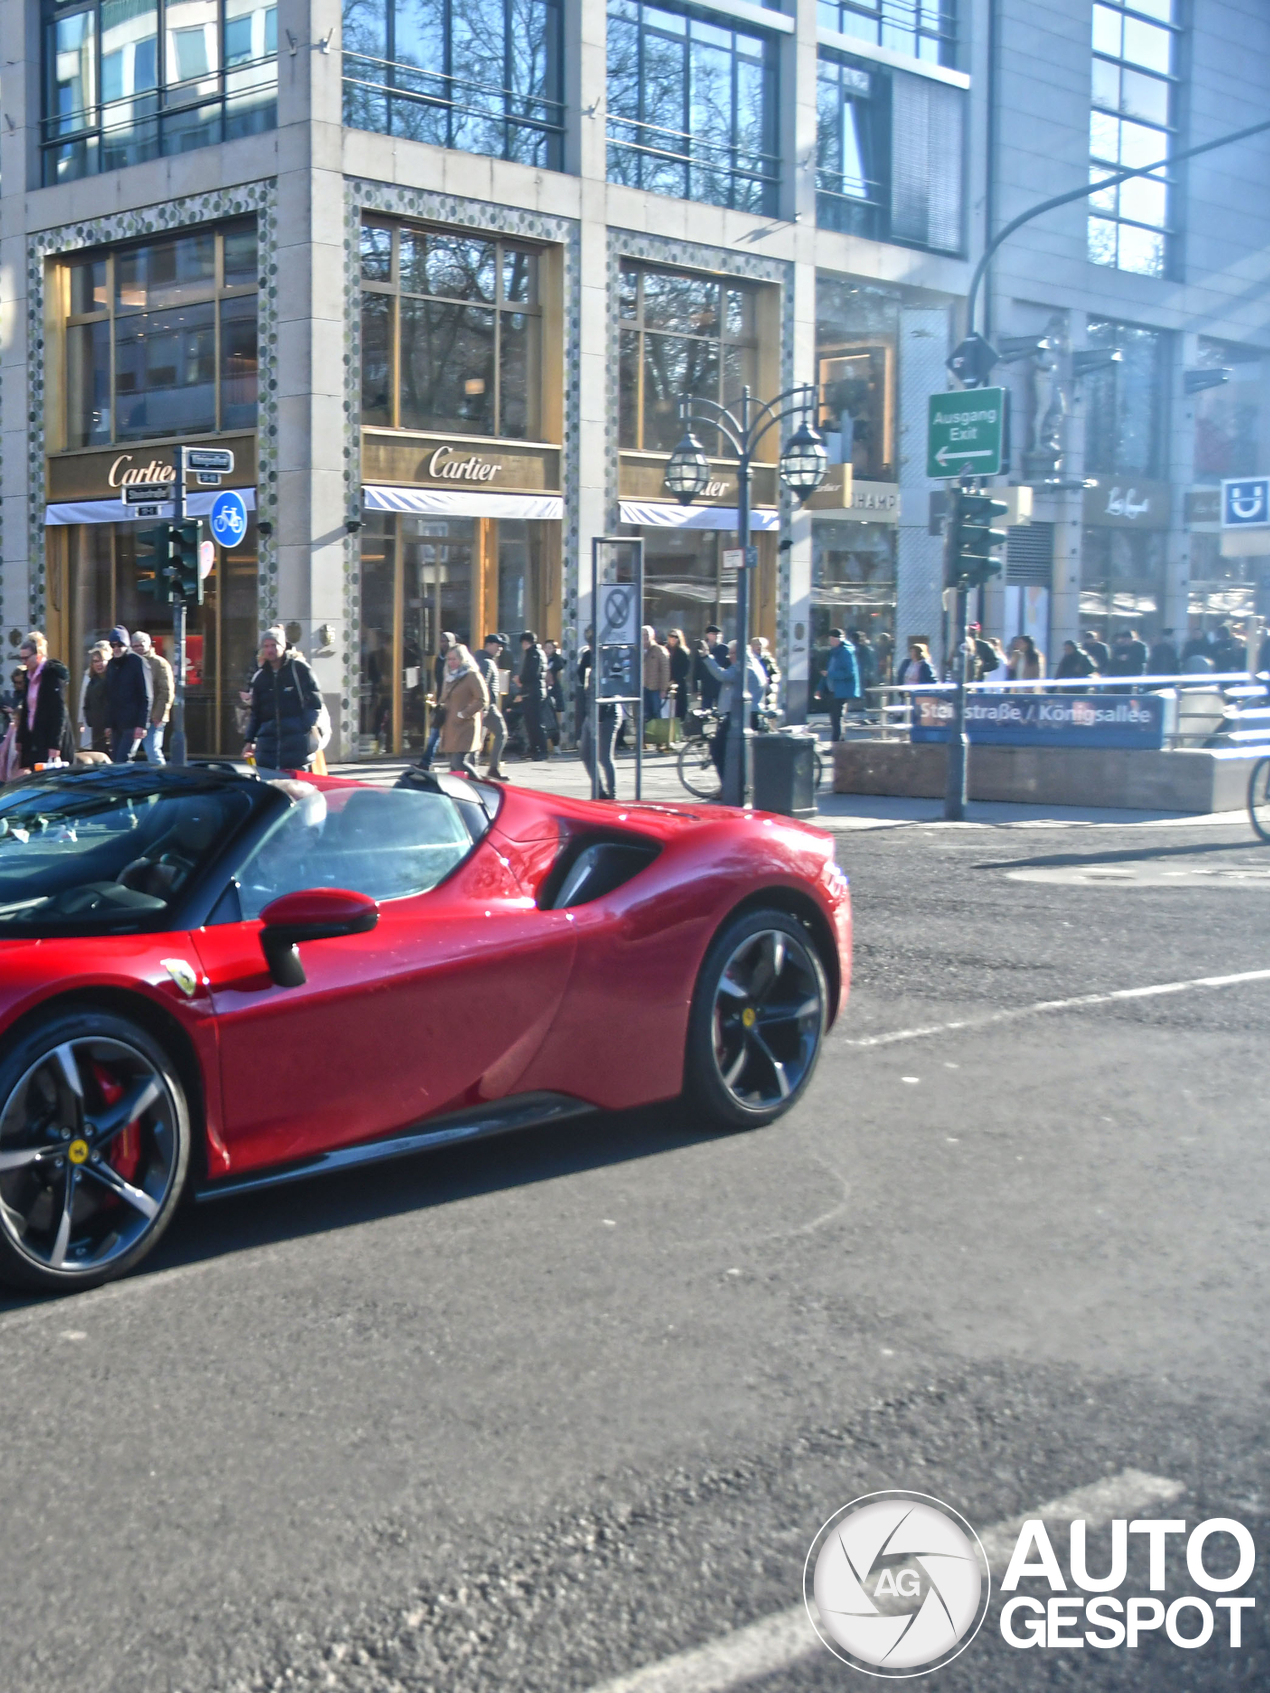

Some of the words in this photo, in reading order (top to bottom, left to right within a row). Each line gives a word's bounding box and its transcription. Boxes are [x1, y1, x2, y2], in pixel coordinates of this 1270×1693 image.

[933, 409, 997, 425] Ausgang
[950, 426, 978, 441] Exit
[429, 446, 502, 481] Cartier
[921, 703, 1020, 722] Steistraße
[1026, 704, 1034, 721] /
[1039, 704, 1151, 726] Königsallee
